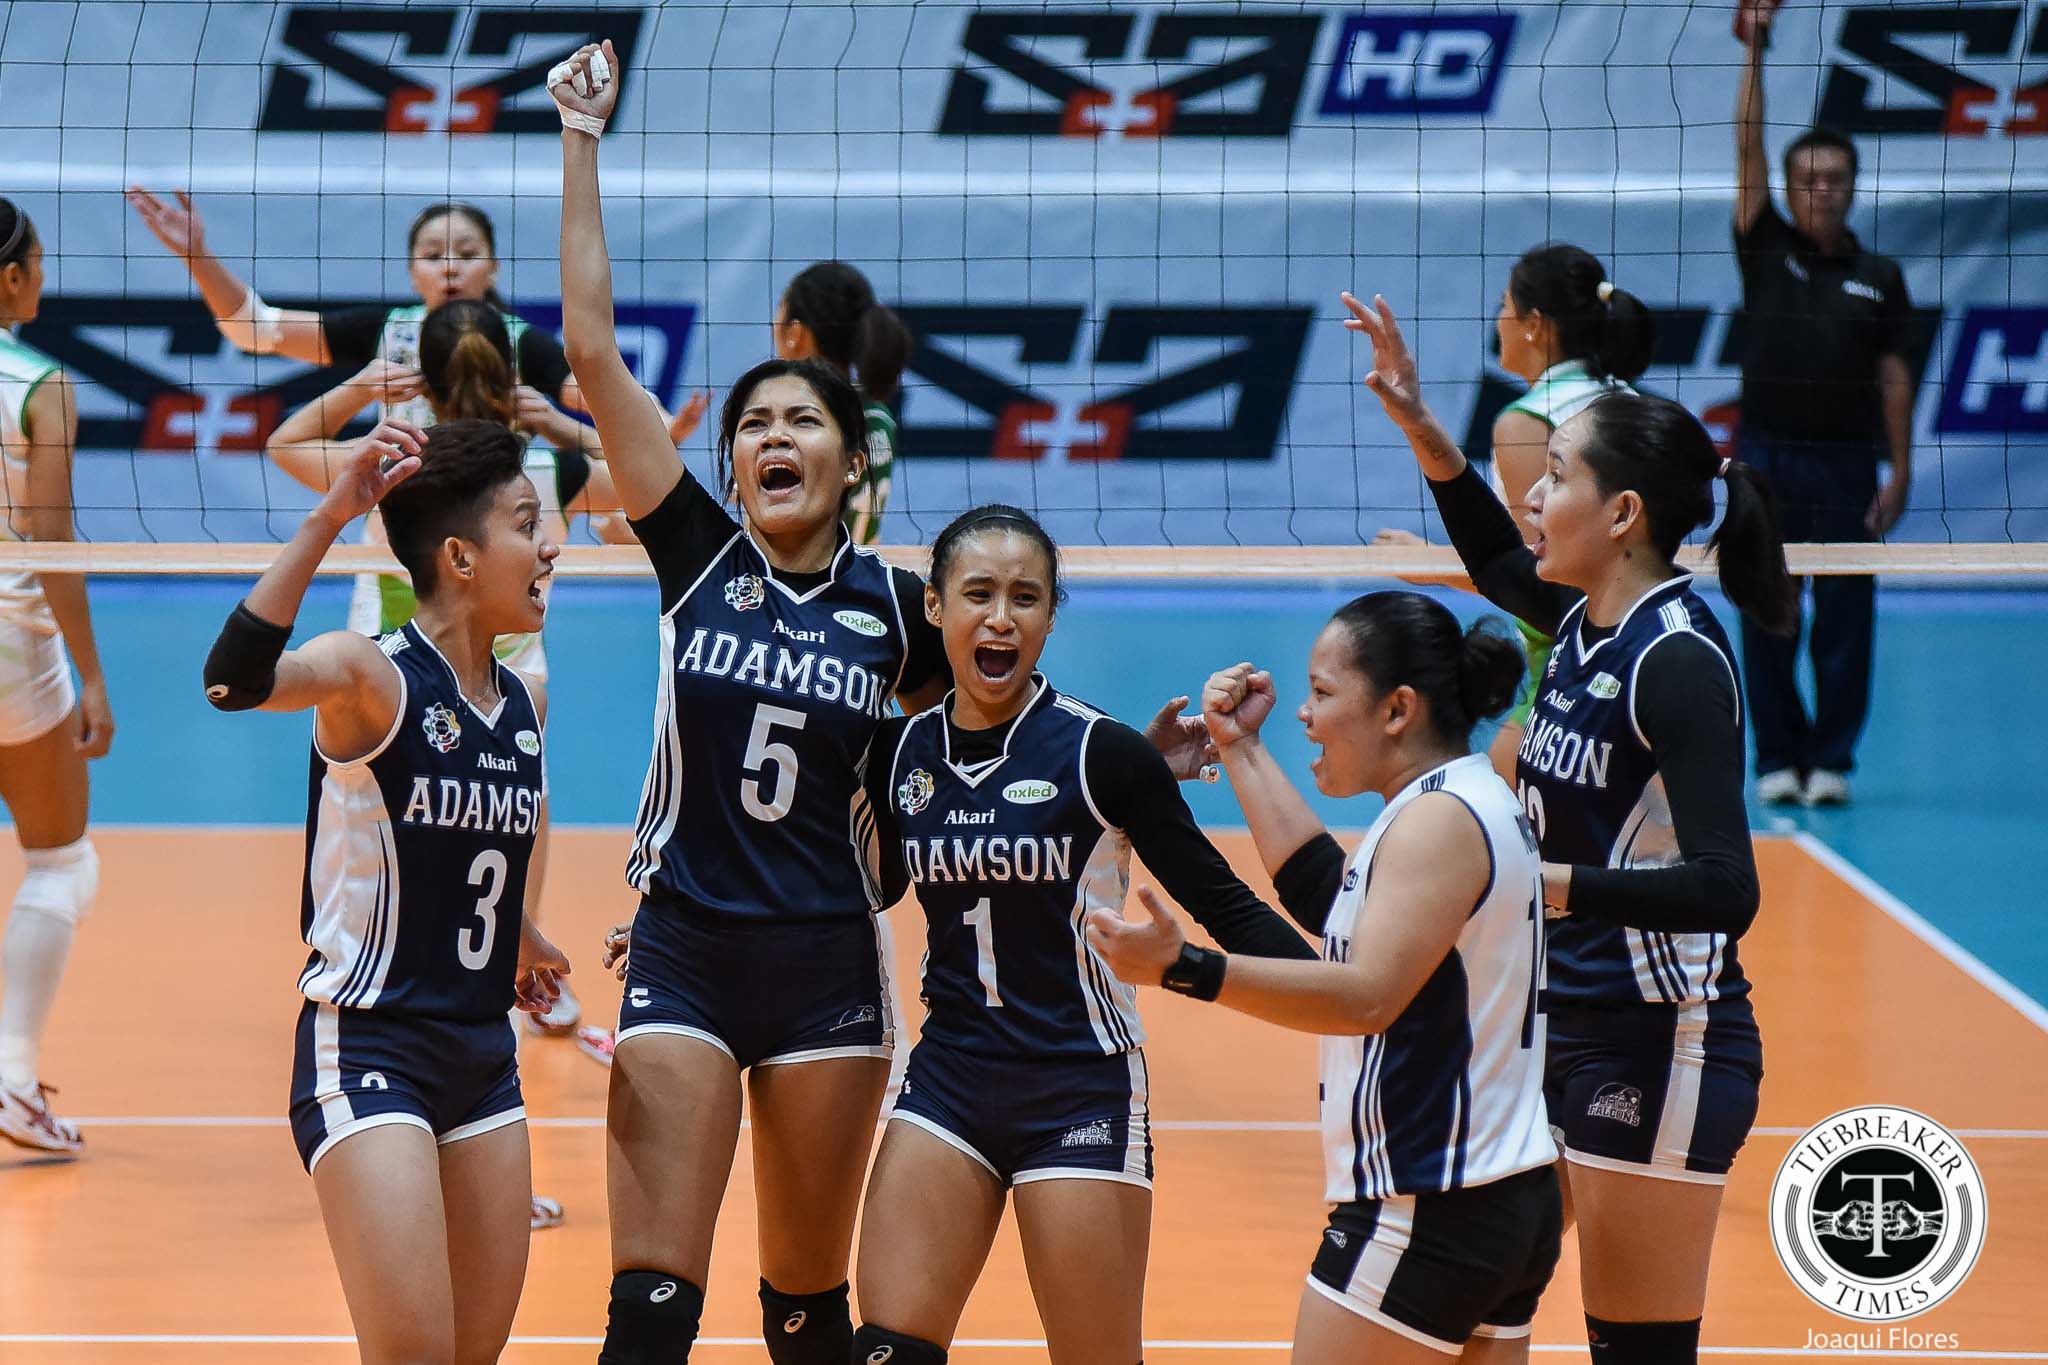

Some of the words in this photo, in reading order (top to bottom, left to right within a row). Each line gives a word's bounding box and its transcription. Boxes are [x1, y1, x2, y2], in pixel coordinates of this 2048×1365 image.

[1337, 29, 1495, 98] HD
[1959, 328, 2048, 414] H
[772, 619, 827, 644] Akari
[838, 613, 883, 635] nxled
[677, 627, 888, 720] ADAMSON
[477, 752, 518, 772] Akari
[518, 737, 538, 751] nxle
[740, 702, 808, 823] 5
[1518, 705, 1613, 788] AMSON
[403, 776, 542, 836] ADAMSO
[943, 808, 996, 825] Akari
[1007, 785, 1052, 799] nxled
[903, 836, 1073, 883] DAMSON
[457, 849, 507, 971] 3
[963, 897, 1004, 1008] 1
[1587, 1103, 1641, 1127] FALCONS
